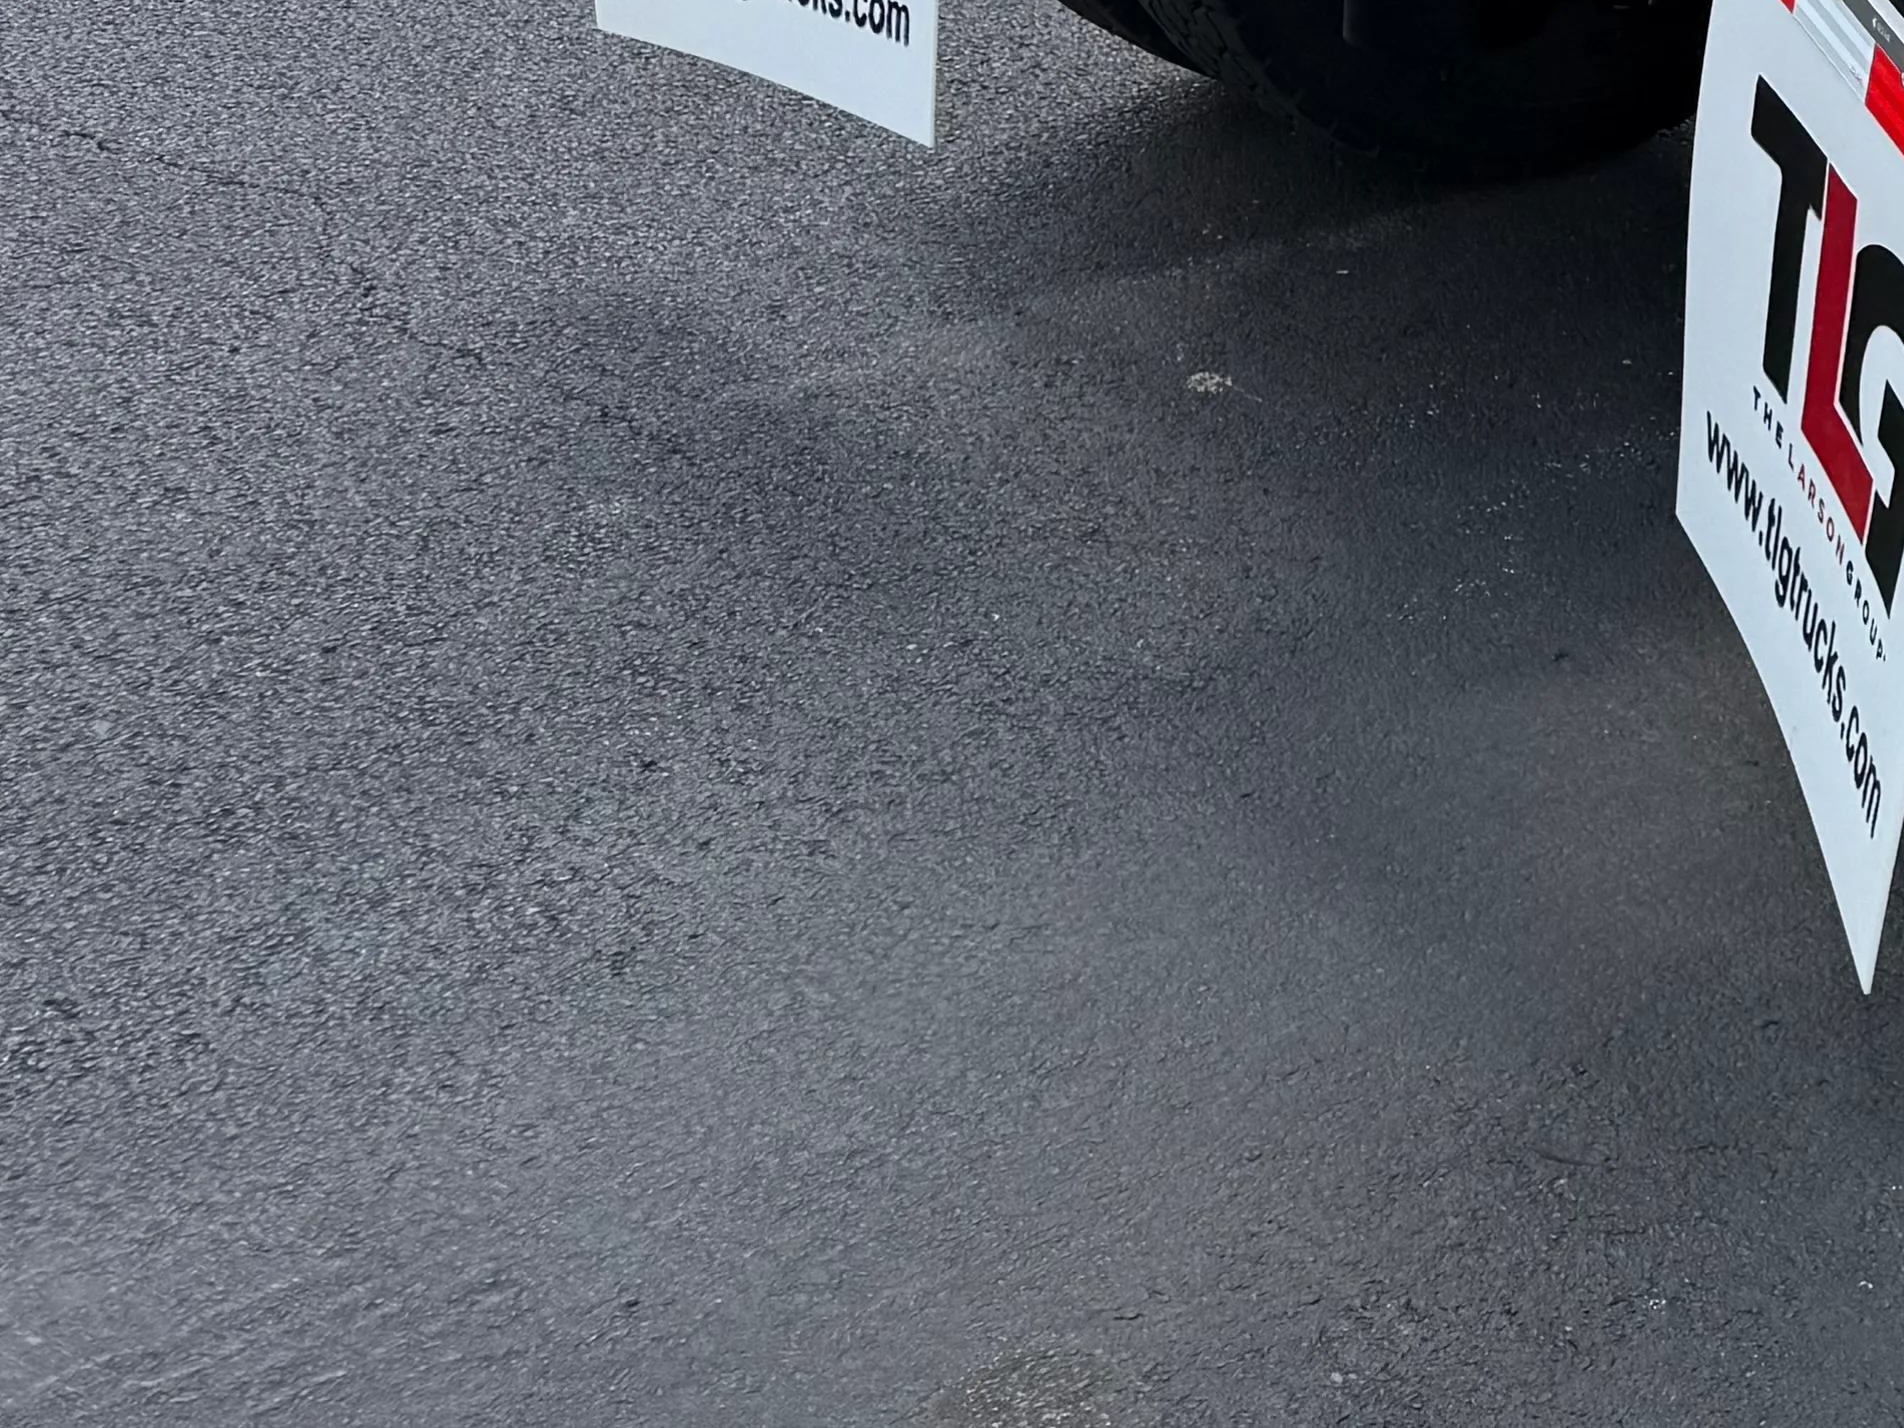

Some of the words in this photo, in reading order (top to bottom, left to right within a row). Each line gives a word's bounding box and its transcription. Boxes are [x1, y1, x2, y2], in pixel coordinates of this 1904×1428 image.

[1705, 410, 1882, 841] www.tlgtrucks.com
[1752, 385, 1785, 450] THE
[1786, 442, 1844, 566] LARSON
[1845, 558, 1884, 661] GROUP
